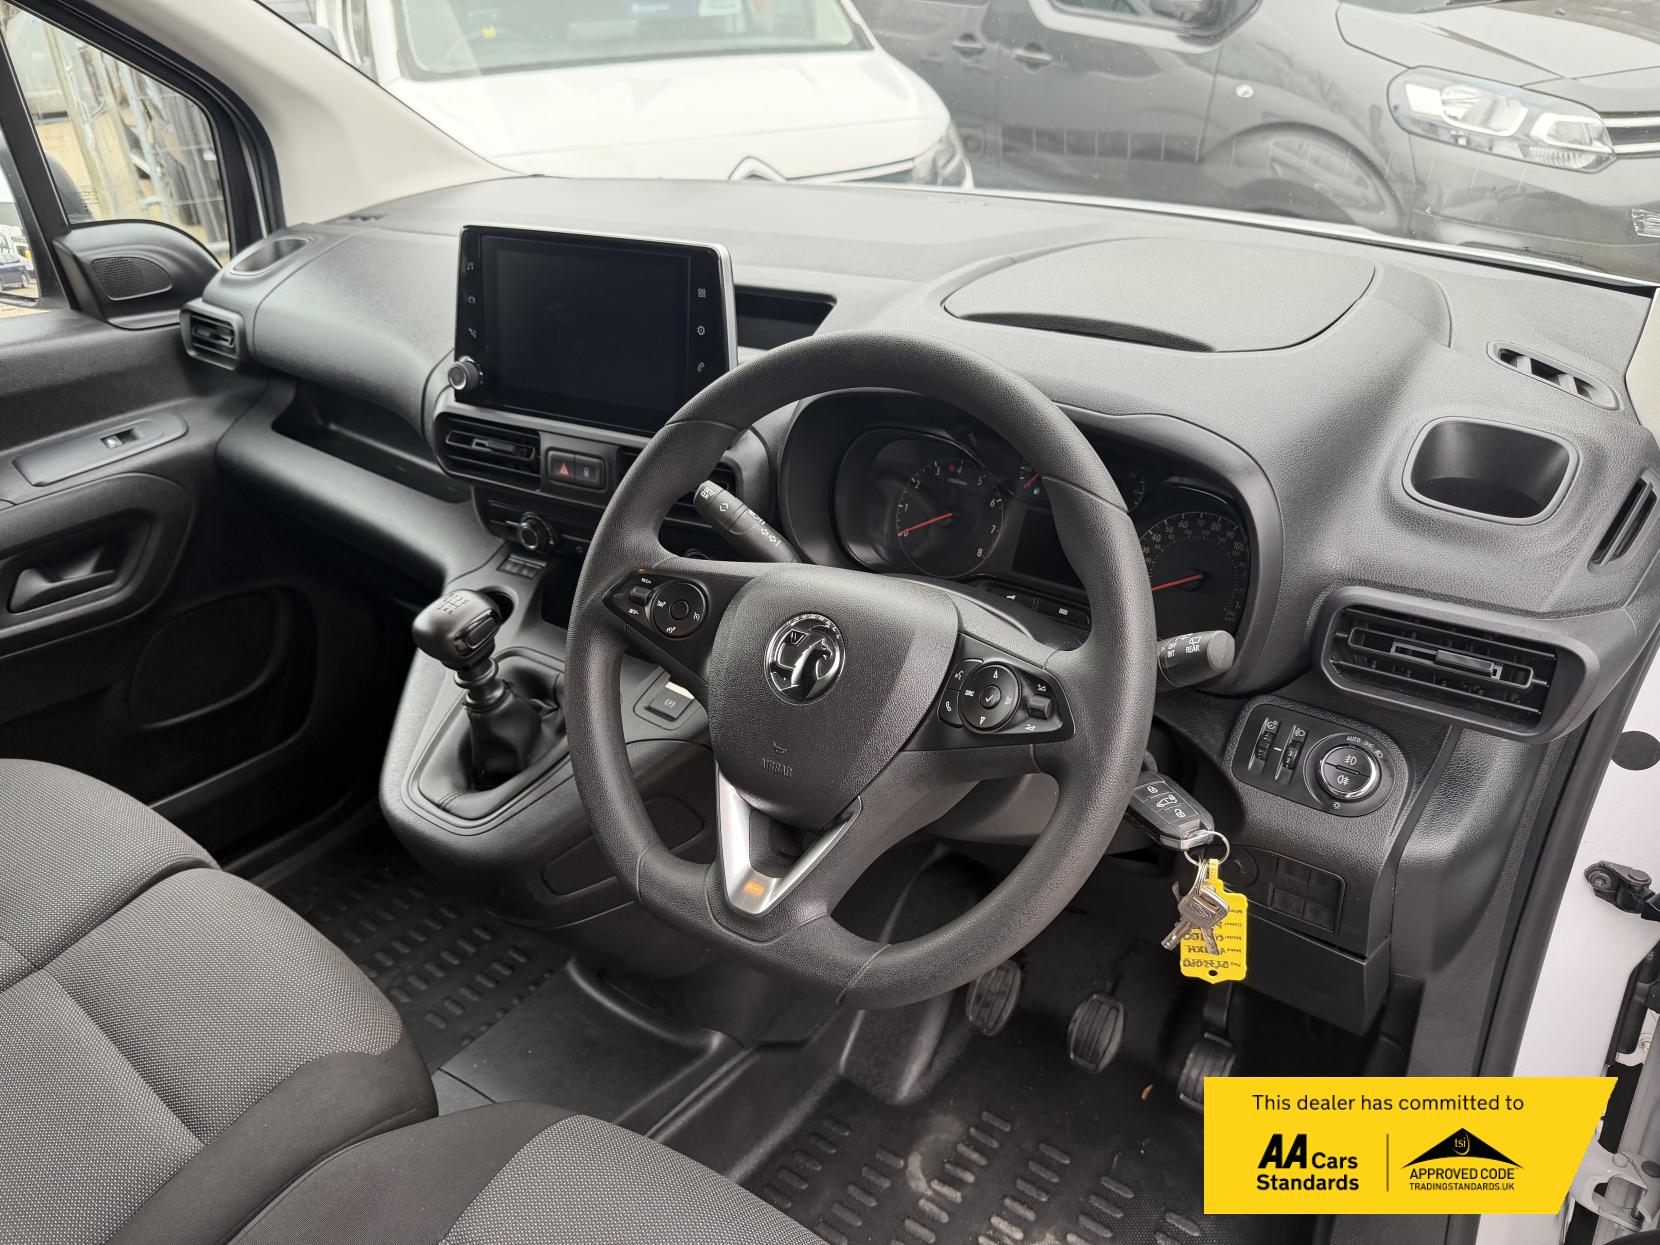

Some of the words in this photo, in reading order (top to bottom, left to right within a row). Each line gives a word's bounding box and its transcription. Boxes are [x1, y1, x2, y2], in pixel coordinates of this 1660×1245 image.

[1178, 521, 1188, 529] 60
[1167, 650, 1175, 658] INT
[1185, 645, 1200, 654] REAR
[1346, 735, 1361, 744] AUTO
[761, 757, 793, 778] AIRBAG
